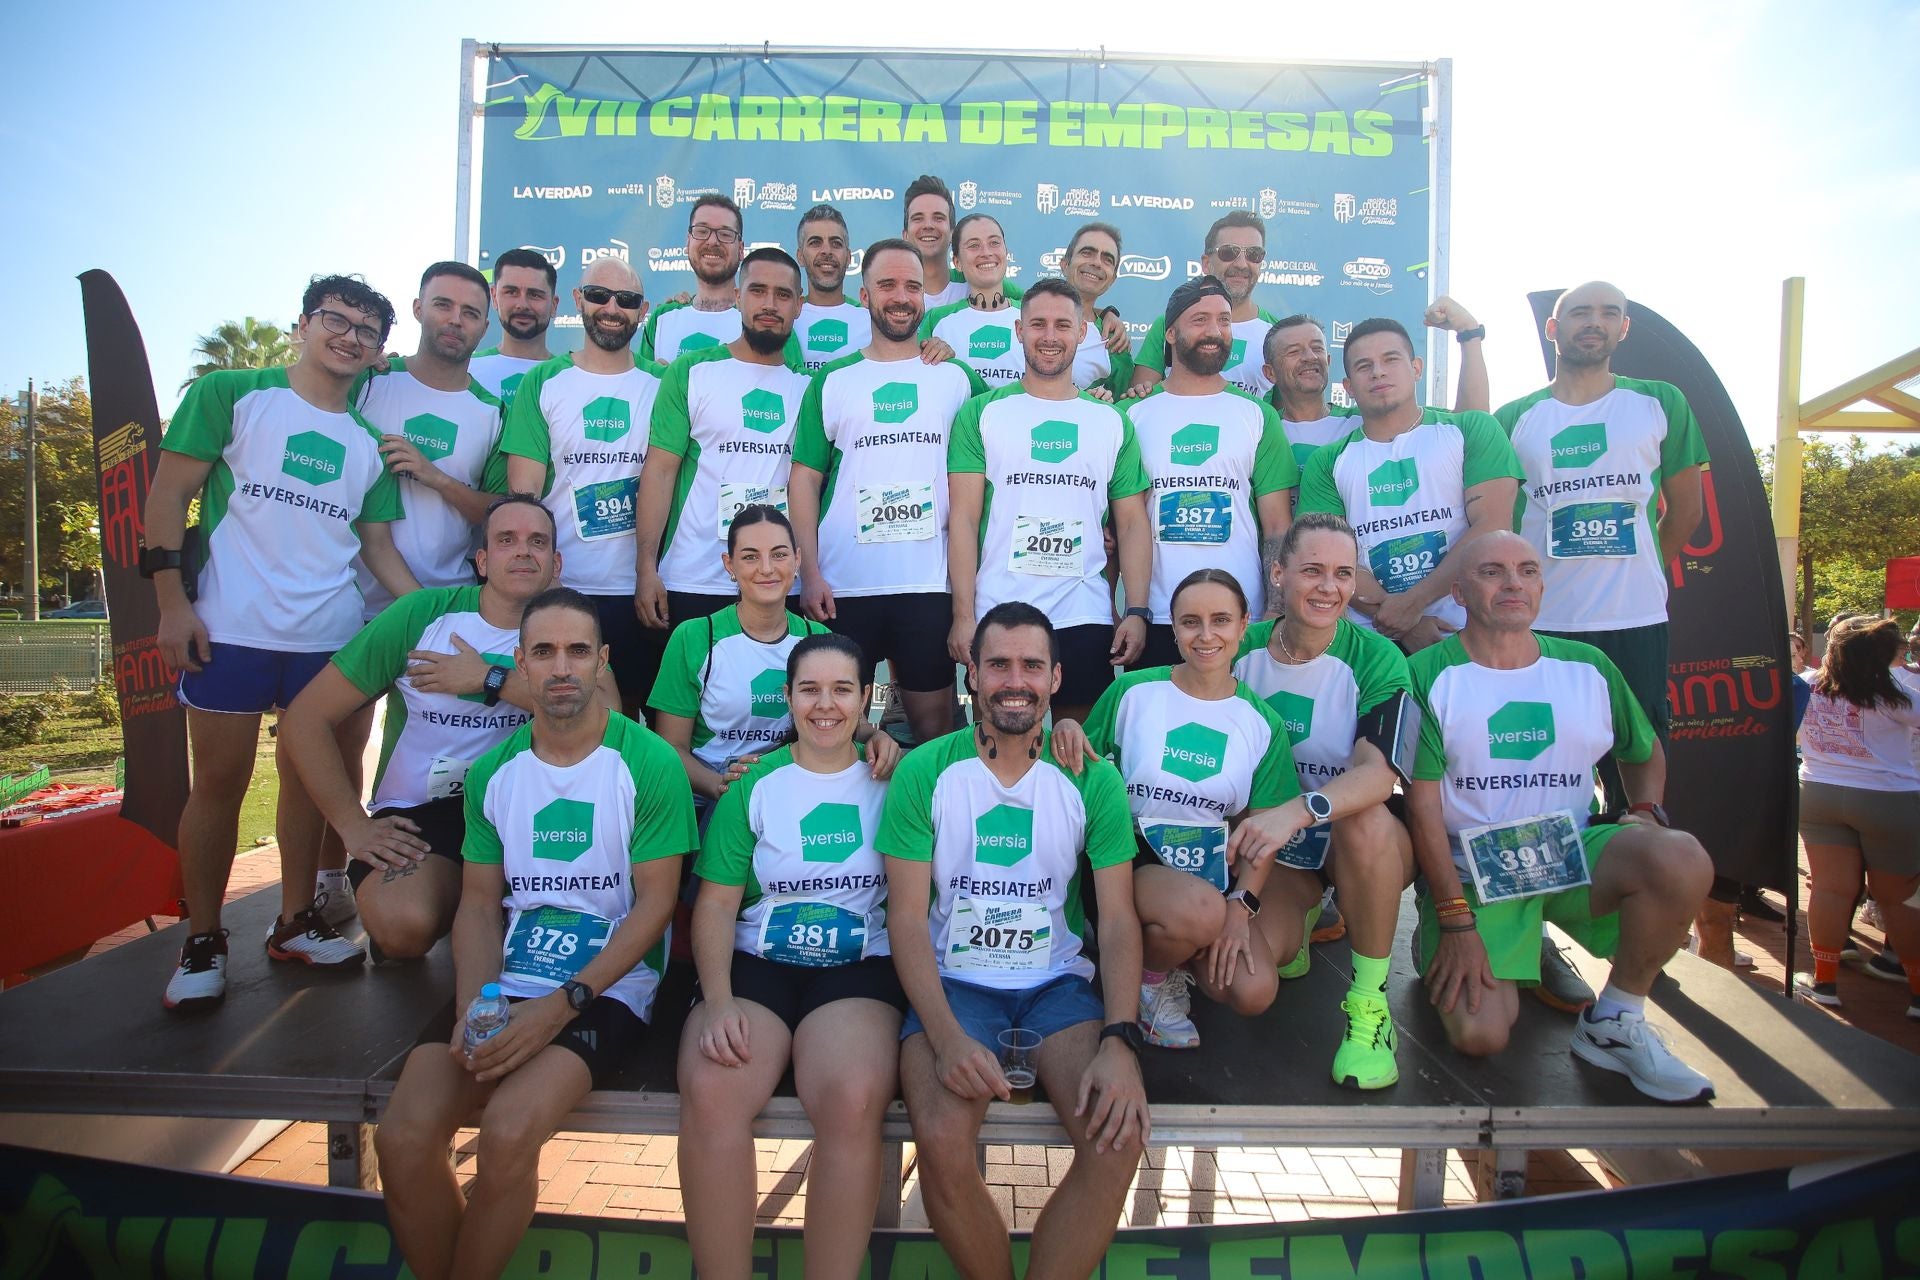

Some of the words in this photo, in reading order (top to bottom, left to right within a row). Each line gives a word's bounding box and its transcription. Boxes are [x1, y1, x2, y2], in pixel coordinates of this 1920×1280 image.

[649, 94, 949, 144] CARRERA
[959, 100, 1038, 146] DE
[1048, 101, 1395, 158] EMPRESAS
[513, 186, 535, 199] LA
[535, 184, 593, 199] VERDAD
[607, 186, 645, 195] MURCIA
[676, 186, 719, 196] Ayuntamiento
[676, 195, 685, 203] de
[756, 193, 798, 202] ATLETISMO
[811, 189, 834, 202] LA
[834, 187, 895, 201] VERDAD
[978, 189, 1023, 199] Ayuntamiento
[1060, 199, 1101, 208] ATLETISMO
[1111, 195, 1133, 207] LA
[1133, 195, 1195, 210] VERDAD
[1210, 199, 1248, 208] MURCIA
[1278, 199, 1320, 209] Ayuntamiento
[1278, 206, 1286, 214] de
[1357, 209, 1398, 217] ATLETISMO
[1123, 261, 1164, 274] VIDAL
[807, 332, 844, 343] eversia
[969, 339, 1006, 350] eversia
[741, 406, 780, 421] eversia
[873, 399, 913, 411] eversia
[583, 417, 625, 429] eversia
[402, 430, 449, 451] eversia
[854, 431, 941, 449] #EVERSIATEAM
[1030, 438, 1073, 450] eversia
[1169, 441, 1213, 454] eversia
[1550, 440, 1602, 459] eversia
[283, 449, 336, 475] eversia
[1006, 471, 1097, 492] #EVERSIATEAM
[1368, 476, 1414, 495] eversia
[1533, 472, 1642, 500] #EVERSIATEAM
[241, 481, 350, 522] #EVERSIATEA
[594, 494, 633, 517] 394
[871, 503, 923, 523] 2080
[1175, 507, 1216, 524] 387
[1571, 519, 1618, 538] 395
[1026, 535, 1073, 554] 2079
[1388, 550, 1435, 575] 392
[1669, 658, 1730, 675] LETISMO
[751, 692, 786, 704] eversi
[1487, 727, 1548, 745] eversia
[1162, 744, 1217, 768] eversia
[1455, 772, 1582, 792] #EVERSIATEAM
[532, 826, 587, 843] eversia
[800, 829, 856, 847] eversia
[975, 833, 1027, 850] eversia
[1160, 845, 1205, 868] 383
[1500, 841, 1553, 871] 391
[949, 875, 1052, 899] #EERSIATEAM
[985, 907, 1022, 921] CARRERA
[526, 926, 579, 956] 378
[788, 924, 839, 949] 381
[969, 925, 1034, 950] 2075
